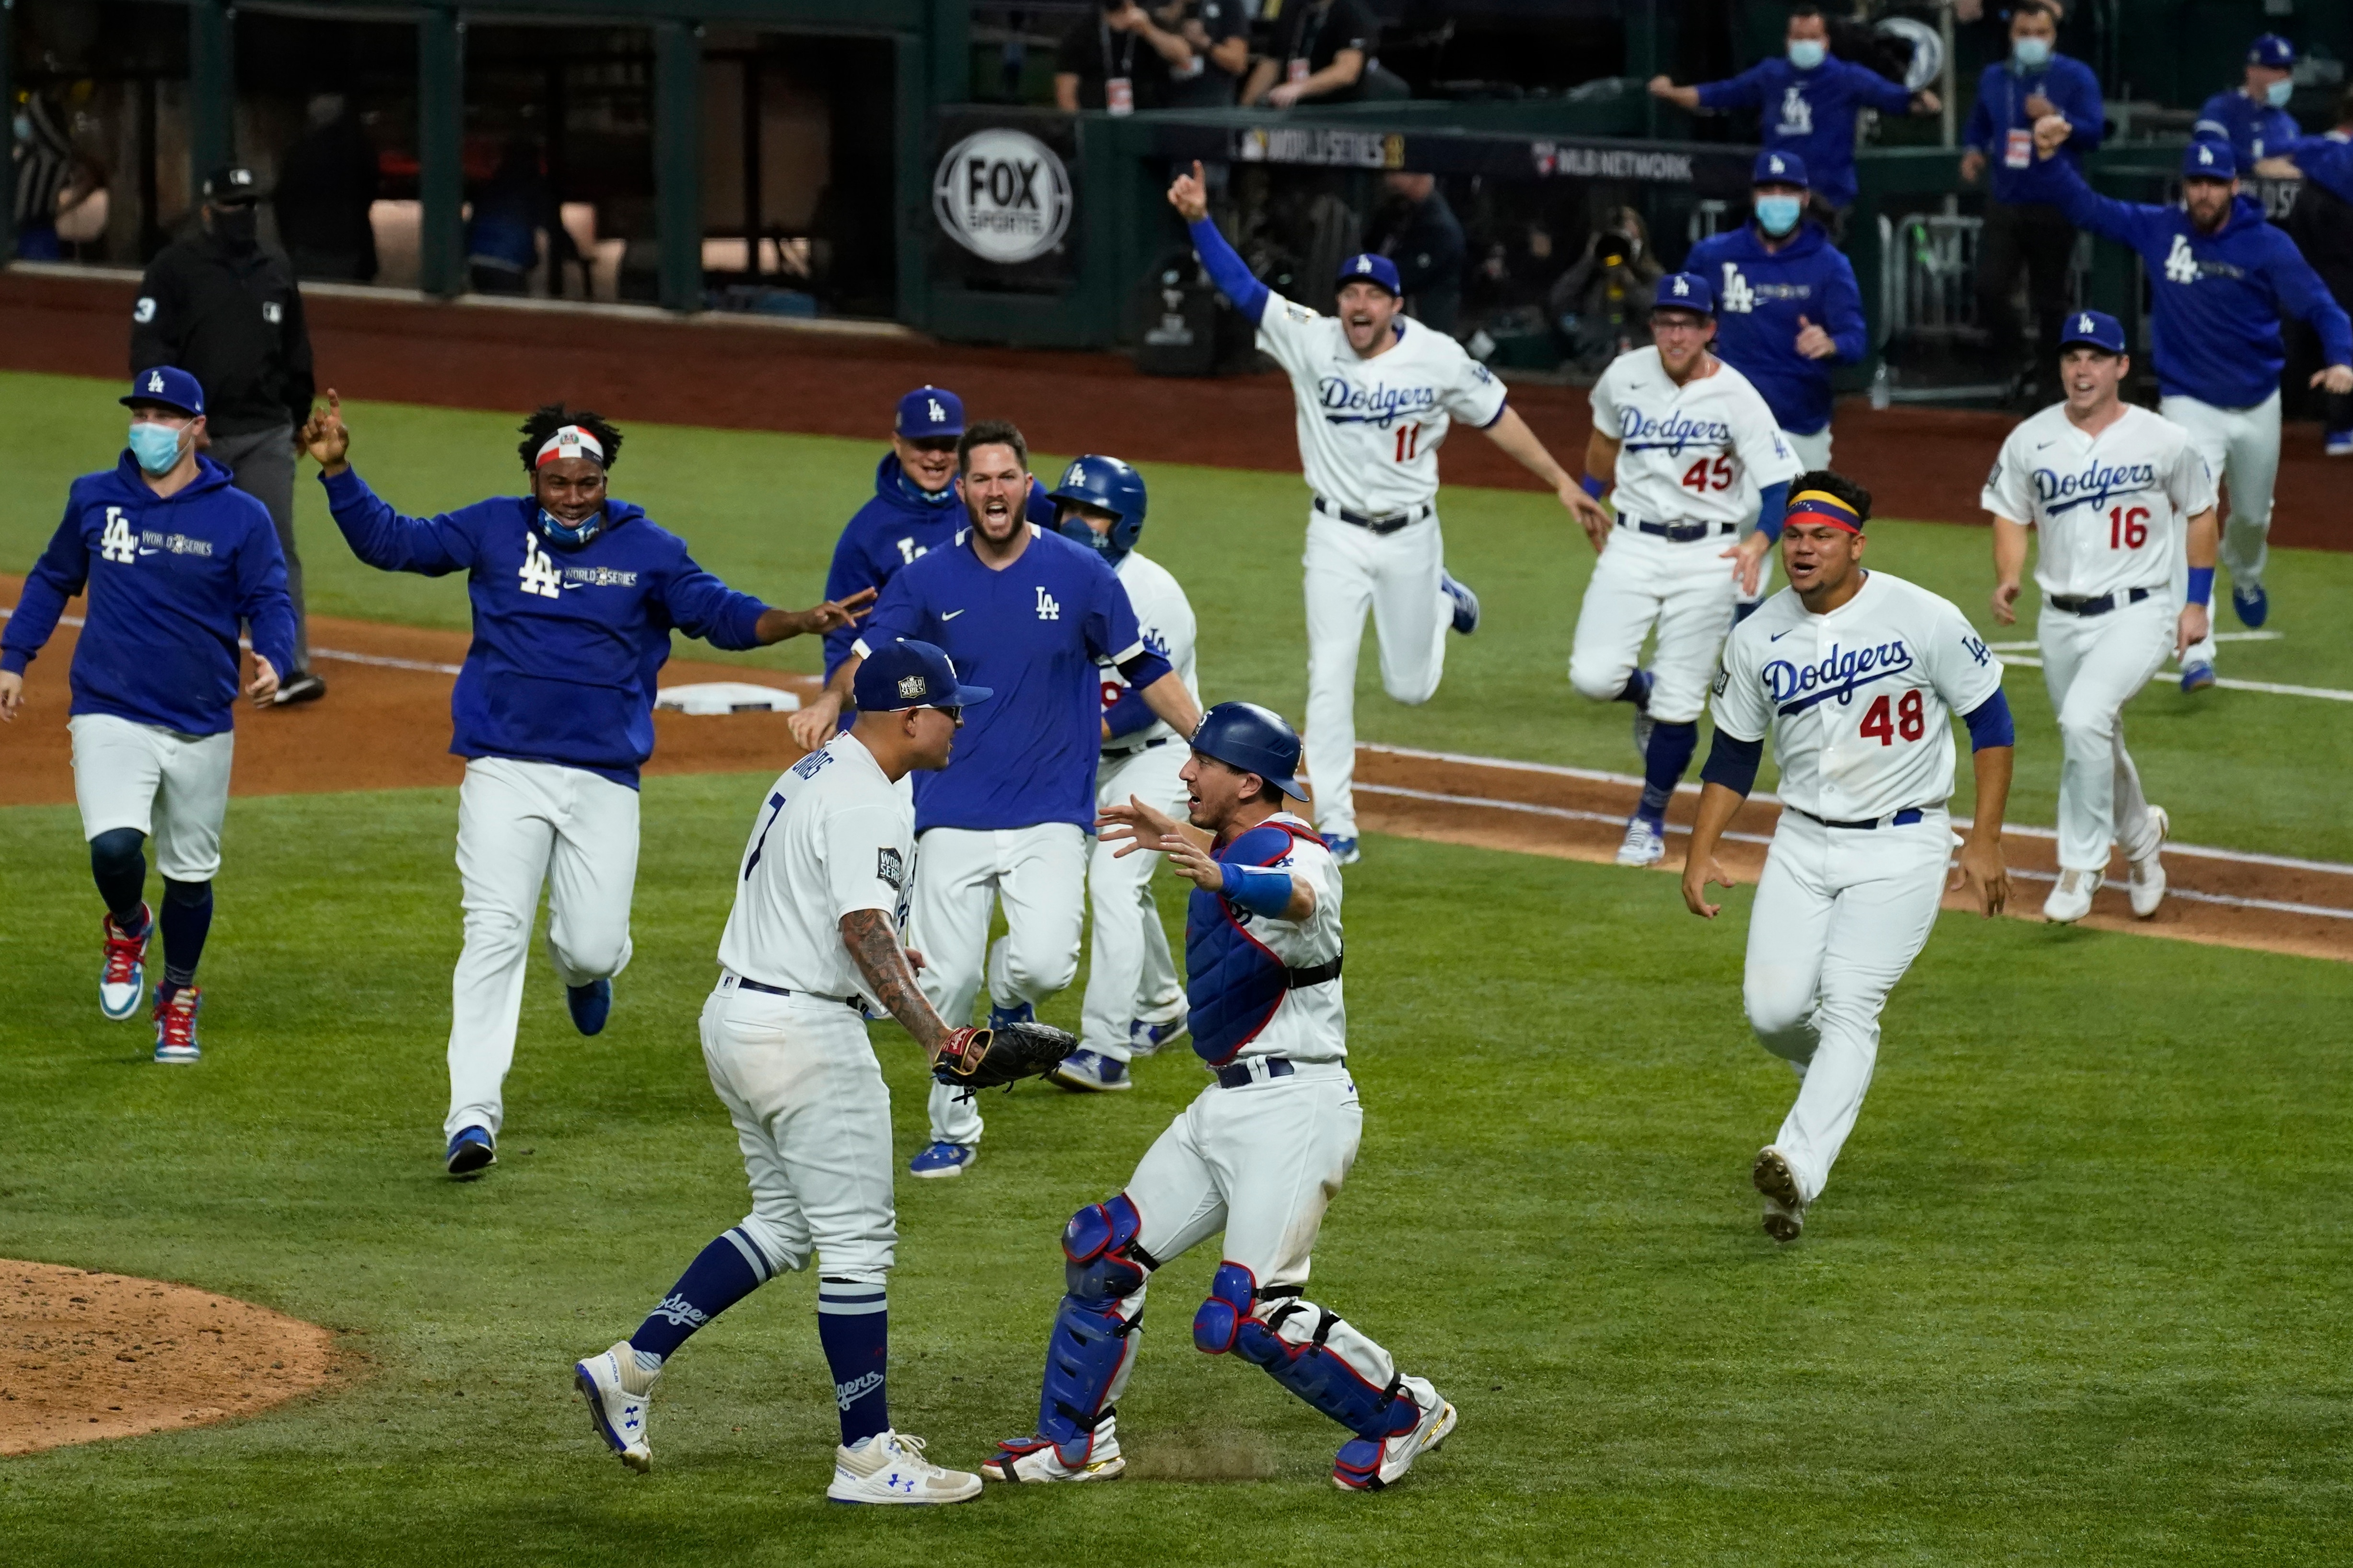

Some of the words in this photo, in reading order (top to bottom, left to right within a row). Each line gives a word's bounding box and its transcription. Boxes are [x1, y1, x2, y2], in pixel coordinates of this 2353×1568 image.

[969, 158, 1038, 209] FOX
[2164, 233, 2198, 285] LA
[1721, 261, 1754, 313] LA
[134, 296, 156, 323] 3
[148, 370, 164, 393] LA
[1319, 376, 1436, 428] Dodgers
[928, 398, 946, 422] LA
[1619, 405, 1732, 458] Dodgers
[1396, 422, 1420, 463] 11
[1068, 463, 1086, 488] LA
[1682, 452, 1733, 493] 45
[2032, 460, 2156, 513] Dodgers
[101, 506, 138, 564] LA
[142, 530, 173, 548] WORD
[2109, 506, 2151, 550] 16
[518, 531, 562, 599] LA
[564, 567, 595, 582] WORLD
[607, 570, 639, 586] SERIES
[1036, 586, 1059, 620] LA
[1962, 636, 1991, 667] LA
[900, 679, 922, 689] WORLD
[901, 686, 923, 695] SERIES
[1762, 641, 1913, 714] Dodgers
[1860, 689, 1925, 746] 48
[745, 791, 786, 882] 7
[880, 851, 901, 873] WORL
